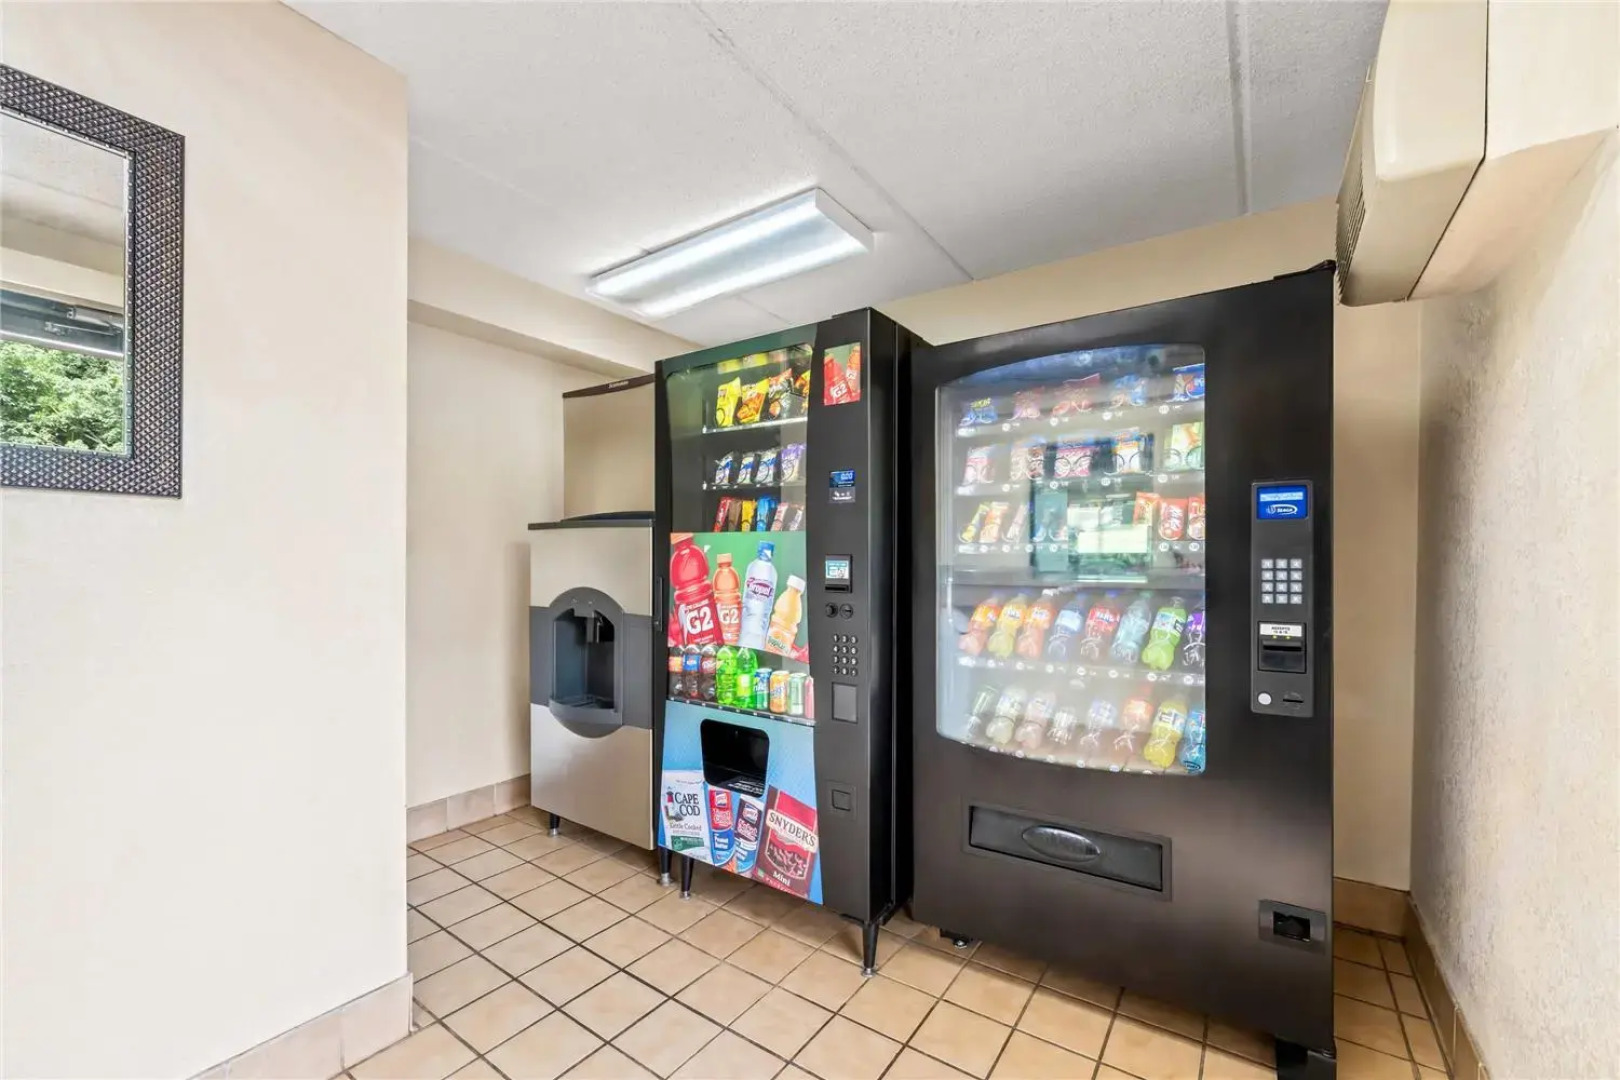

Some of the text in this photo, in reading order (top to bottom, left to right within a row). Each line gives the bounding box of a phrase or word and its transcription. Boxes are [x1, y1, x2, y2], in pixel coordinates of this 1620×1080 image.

[830, 382, 848, 398] G2
[686, 606, 714, 635] G2
[719, 608, 740, 625] G2
[674, 792, 700, 805] CAPE
[679, 804, 701, 816] COD
[769, 812, 816, 847] SNYDER'S
[772, 870, 791, 886] Mini
